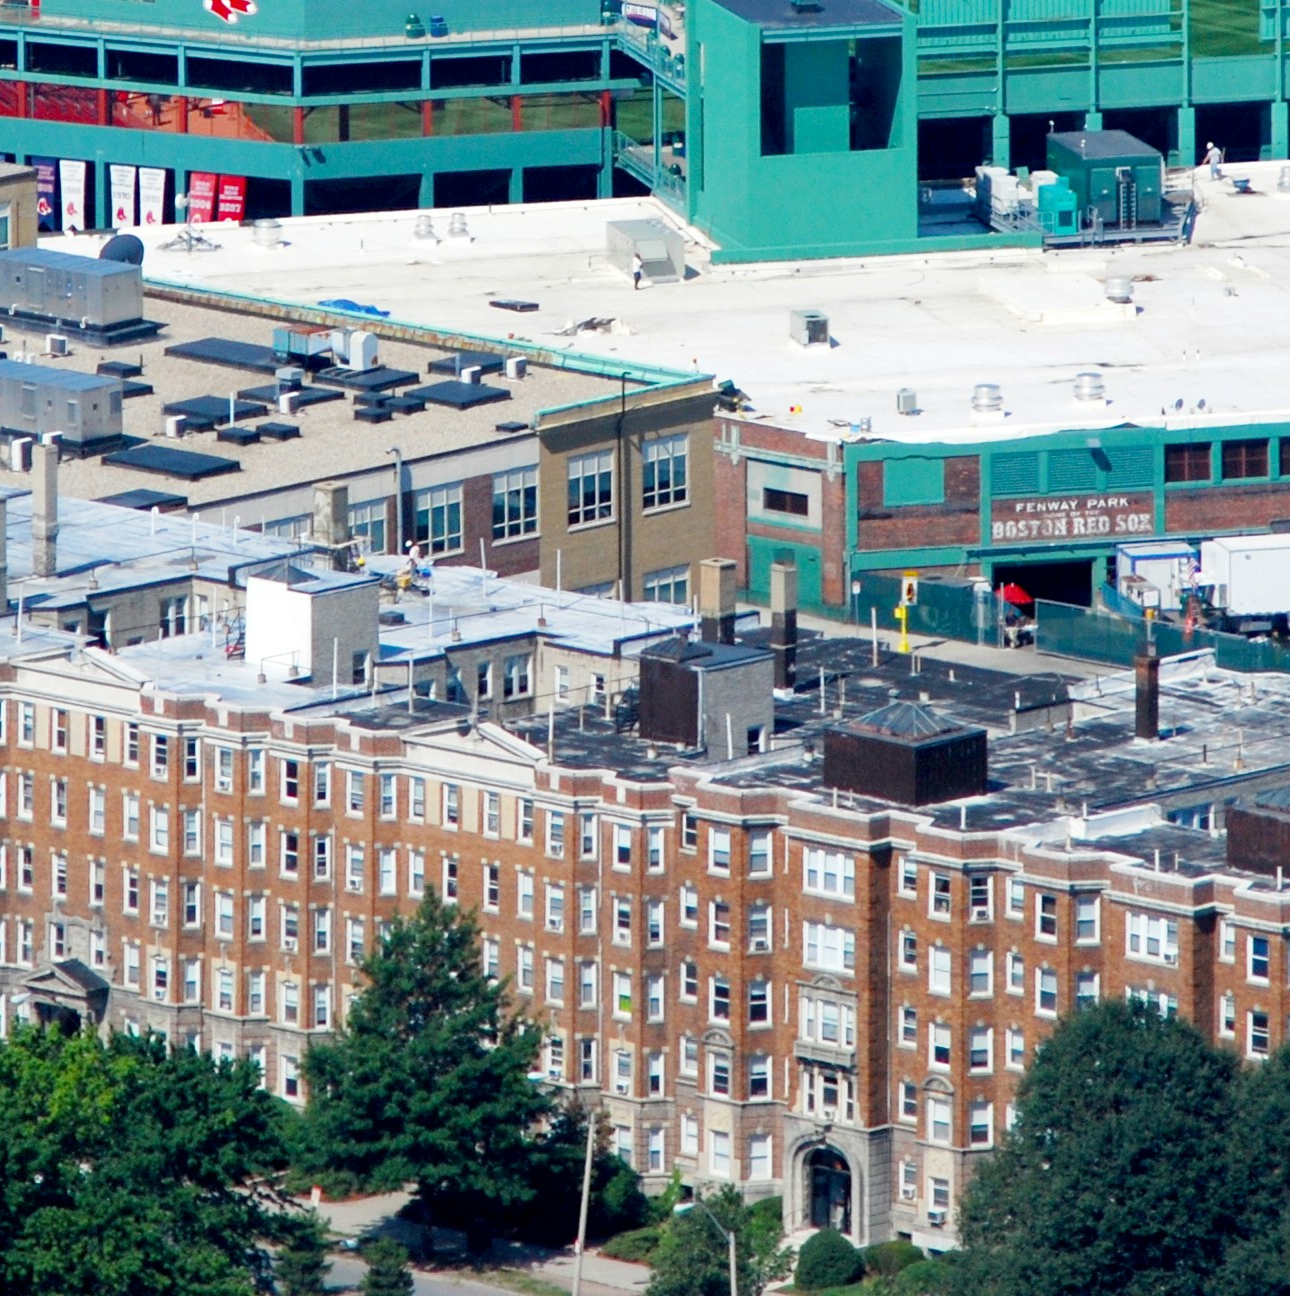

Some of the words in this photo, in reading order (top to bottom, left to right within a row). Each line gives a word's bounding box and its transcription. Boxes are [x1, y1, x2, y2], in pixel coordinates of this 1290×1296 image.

[1015, 499, 1079, 513] FENWAY
[1087, 497, 1129, 509] PARK
[992, 516, 1068, 540] BOSTON
[1072, 515, 1110, 536] RED
[1114, 513, 1153, 532] SOX
